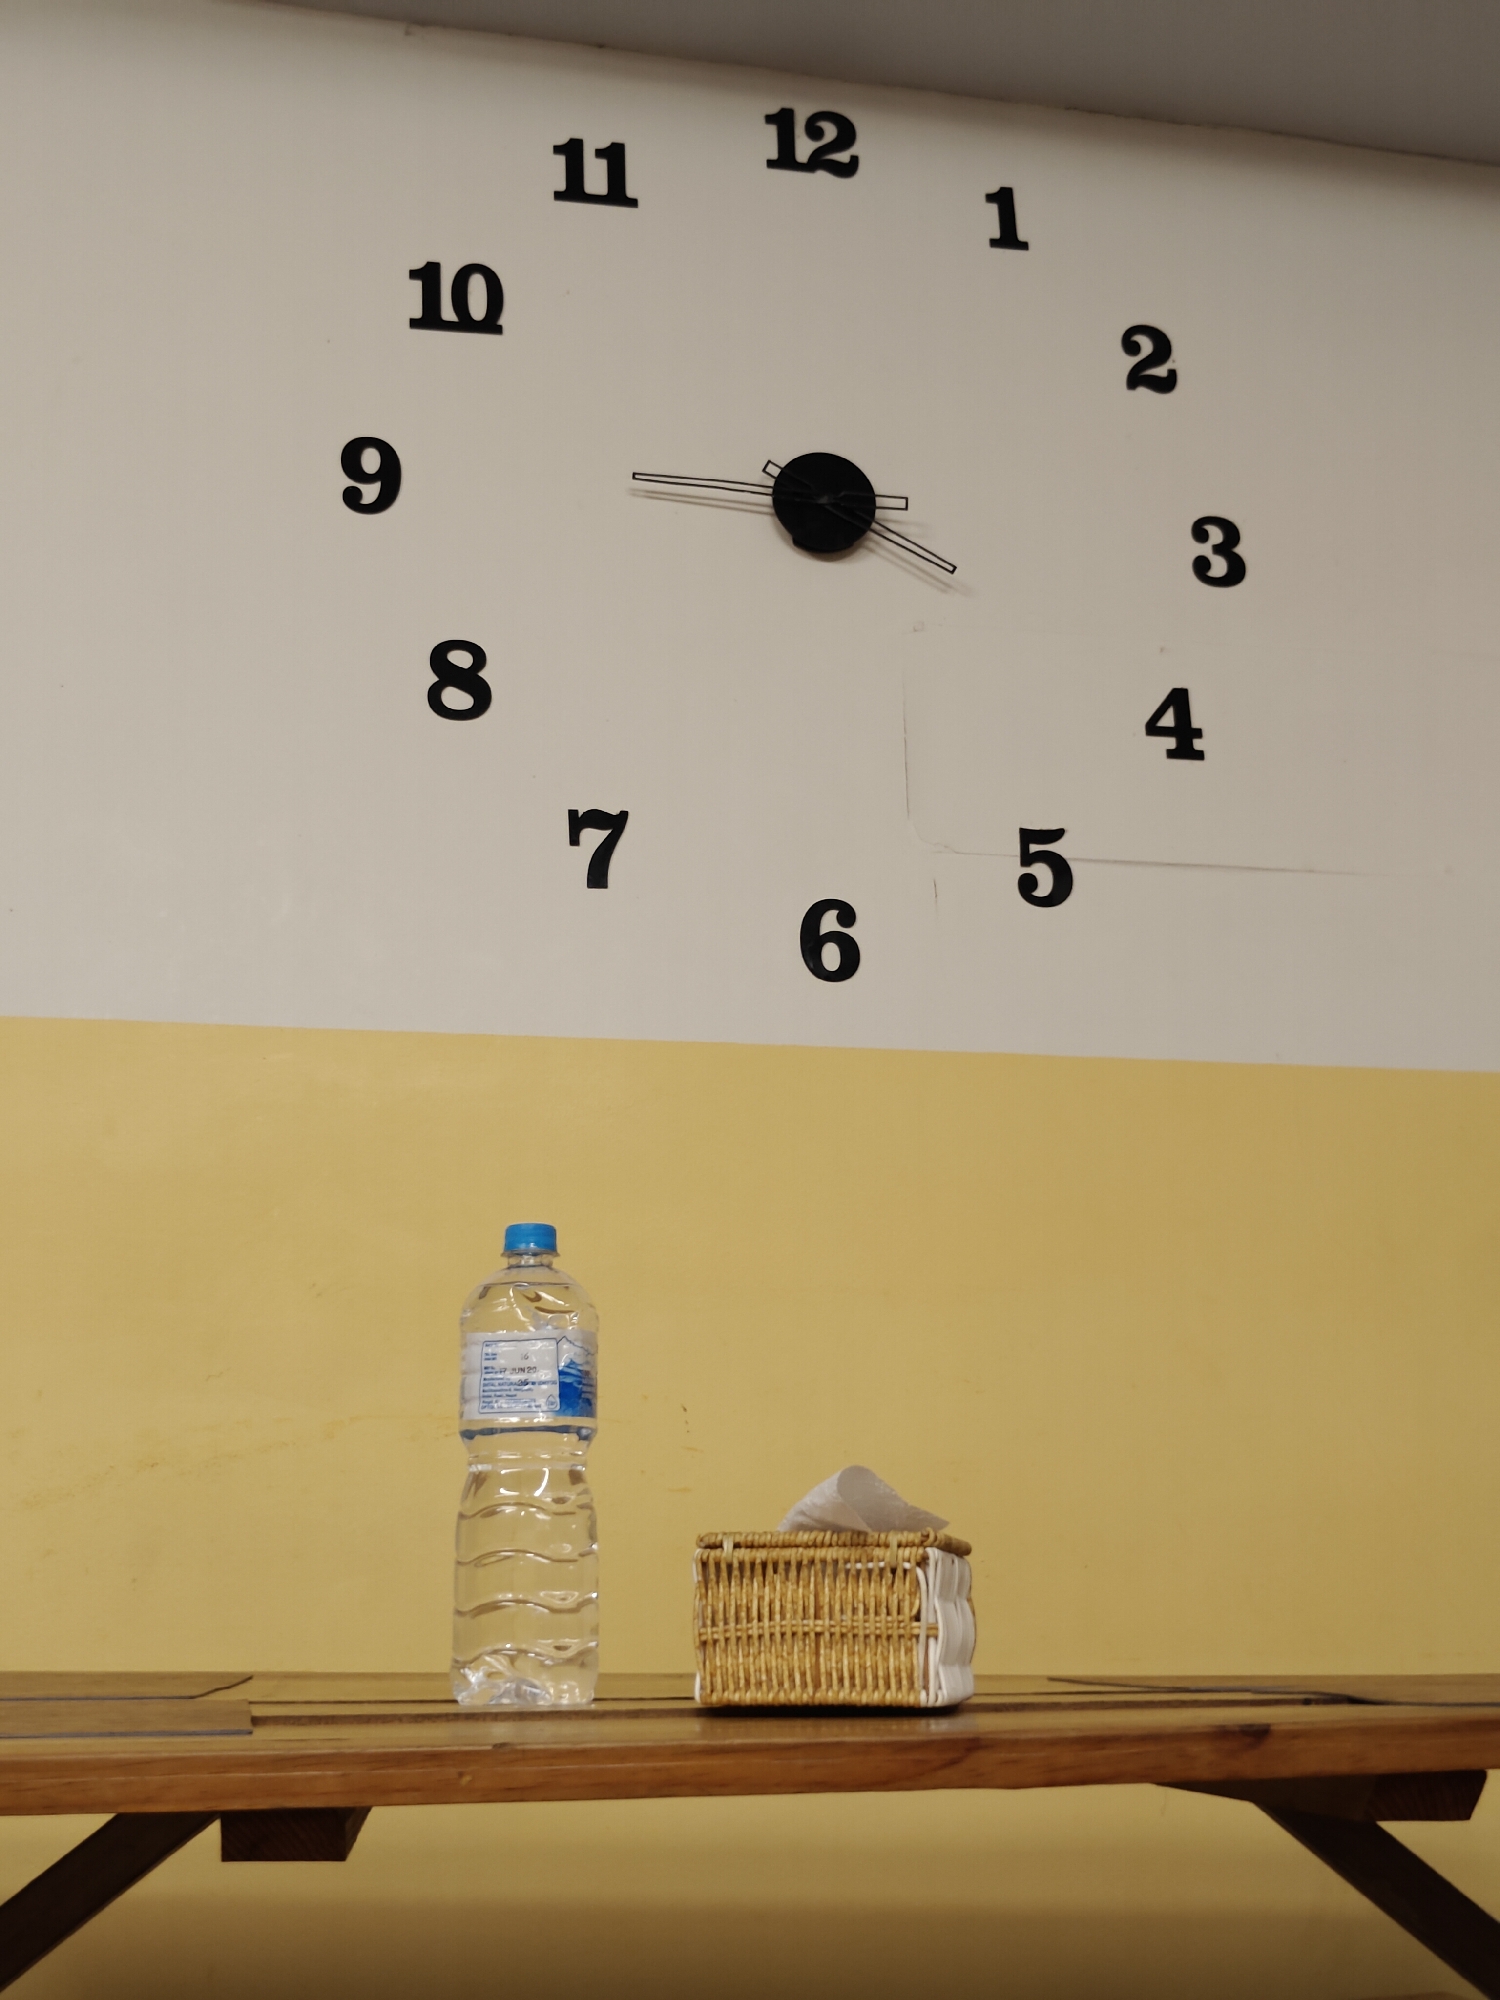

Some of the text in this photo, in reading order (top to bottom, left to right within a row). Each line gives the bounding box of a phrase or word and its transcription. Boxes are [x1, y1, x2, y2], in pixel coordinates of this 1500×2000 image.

[552, 137, 639, 209] 11
[764, 107, 860, 179] 12
[985, 186, 1029, 251] 1
[408, 261, 504, 336] 10
[1121, 324, 1178, 395] 2
[340, 436, 402, 515] 9
[1191, 515, 1247, 588] 3
[427, 639, 492, 721] 8
[1145, 687, 1205, 761] 4
[567, 808, 629, 889] 7
[1017, 827, 1074, 908] 5
[799, 898, 861, 983] 6
[509, 1366, 526, 1375] JUN
